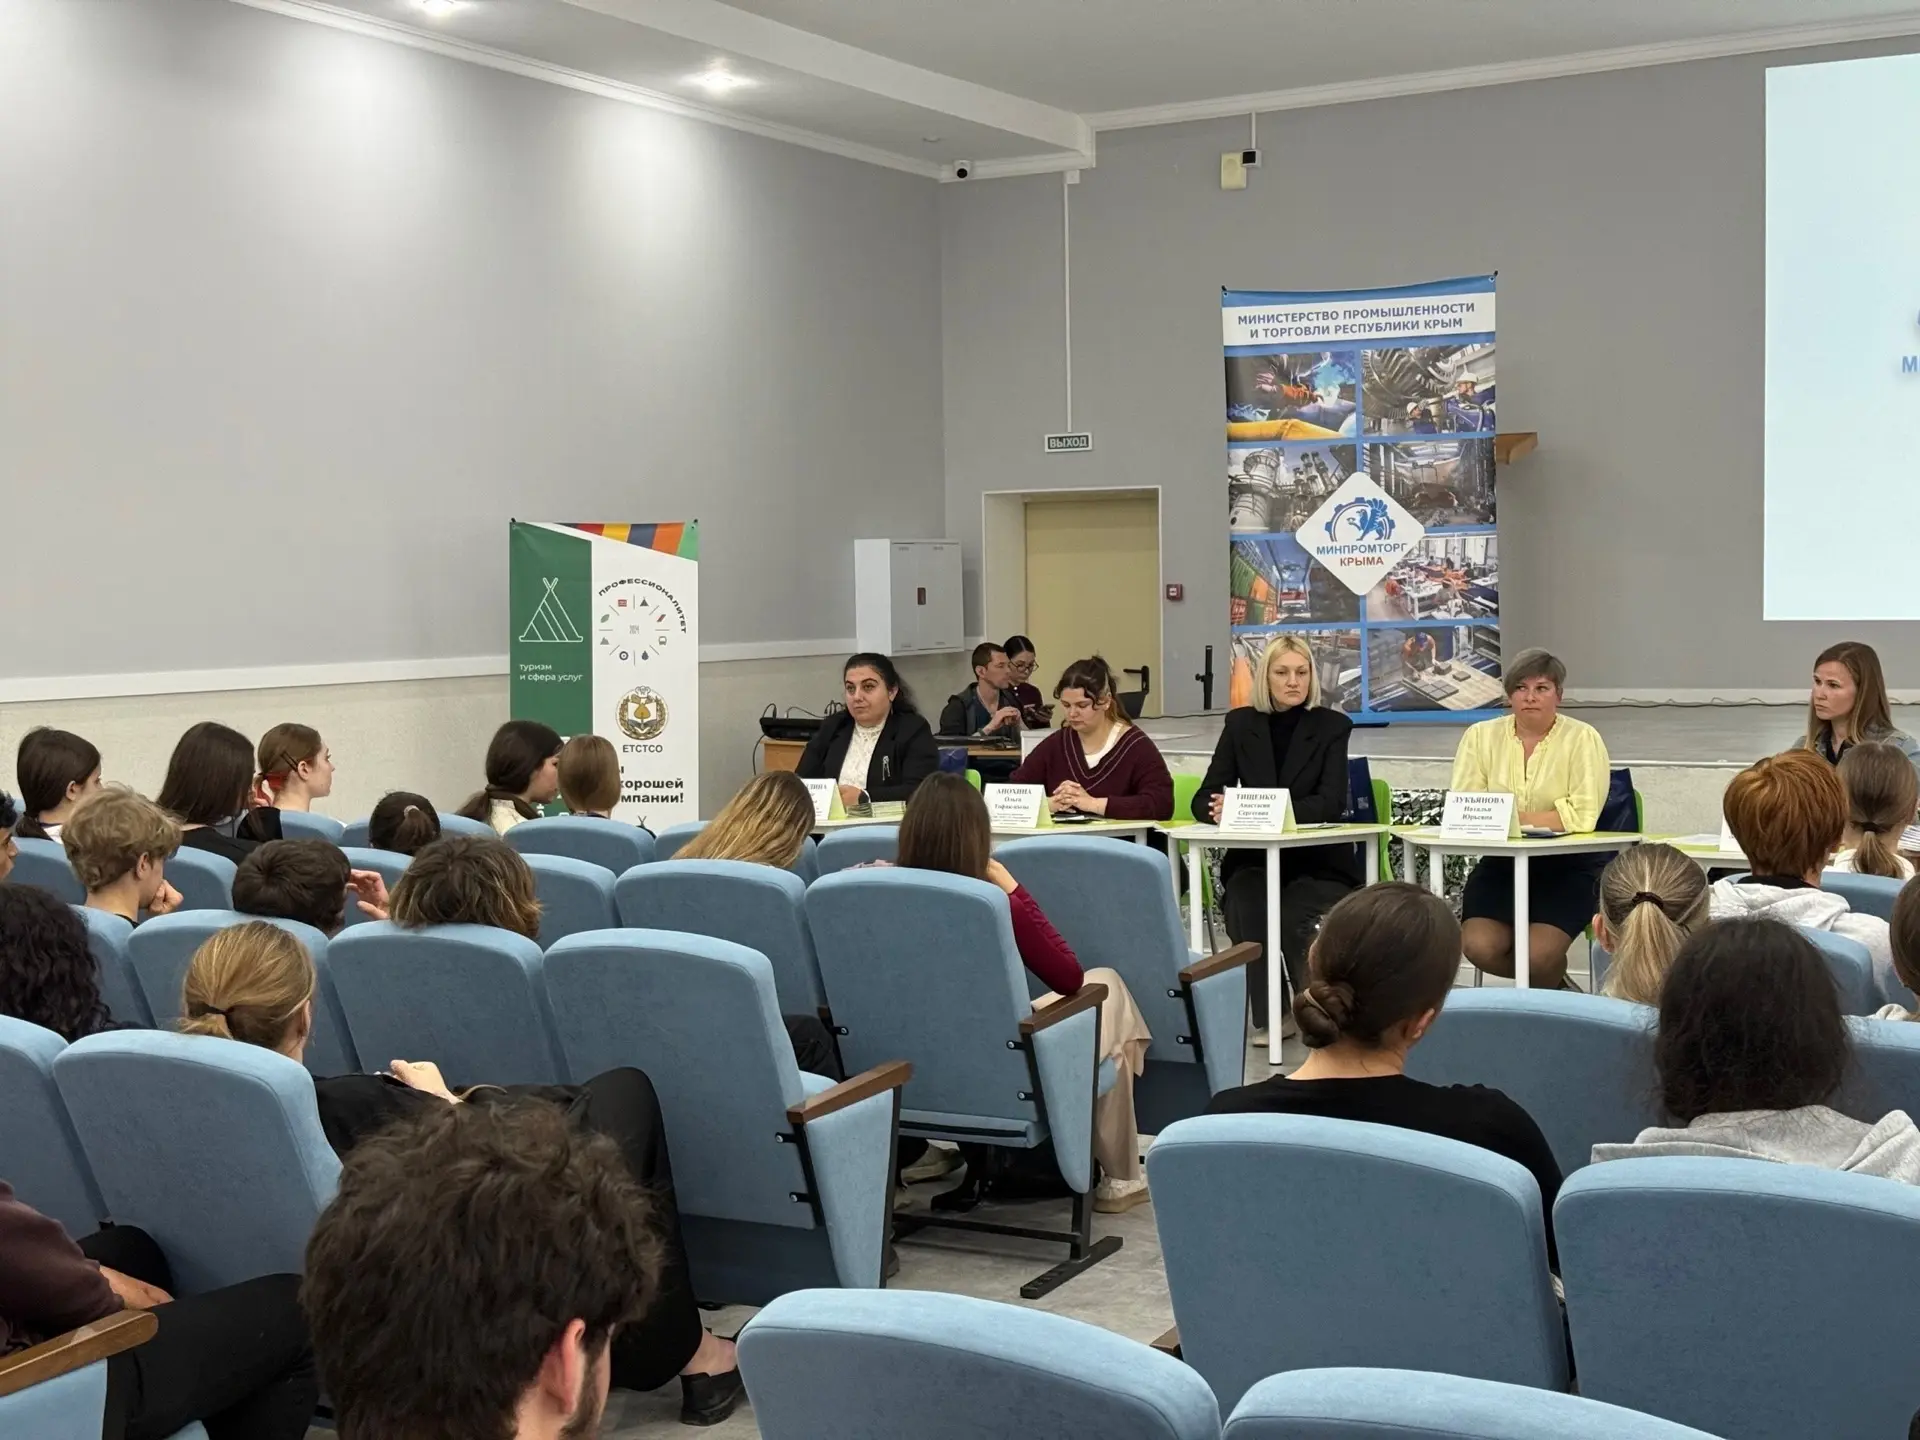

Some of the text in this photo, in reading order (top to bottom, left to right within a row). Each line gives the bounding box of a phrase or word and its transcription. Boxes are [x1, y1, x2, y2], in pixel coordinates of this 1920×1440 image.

[1237, 302, 1475, 325] МИНИСТЕРСТВО ПРОМЫШЛЕННОСТИ
[1249, 317, 1463, 338] И ТОРГОВЛИ РЕСПУБЛИКИ КРЫМ
[1049, 436, 1088, 449] ВЫХОД
[1316, 543, 1408, 555] МИНПРОМТОРГ
[1340, 556, 1384, 567] КРЫМА
[598, 578, 687, 634] ПРОФЕССИОНАЛИТЕТ
[519, 664, 553, 672] туризм
[527, 673, 556, 682] сфера
[557, 674, 583, 683] услуг
[622, 744, 663, 753] ЕТСТСО
[620, 792, 684, 803] мпании!
[1452, 796, 1505, 804] ЛУКЬЯНОВА
